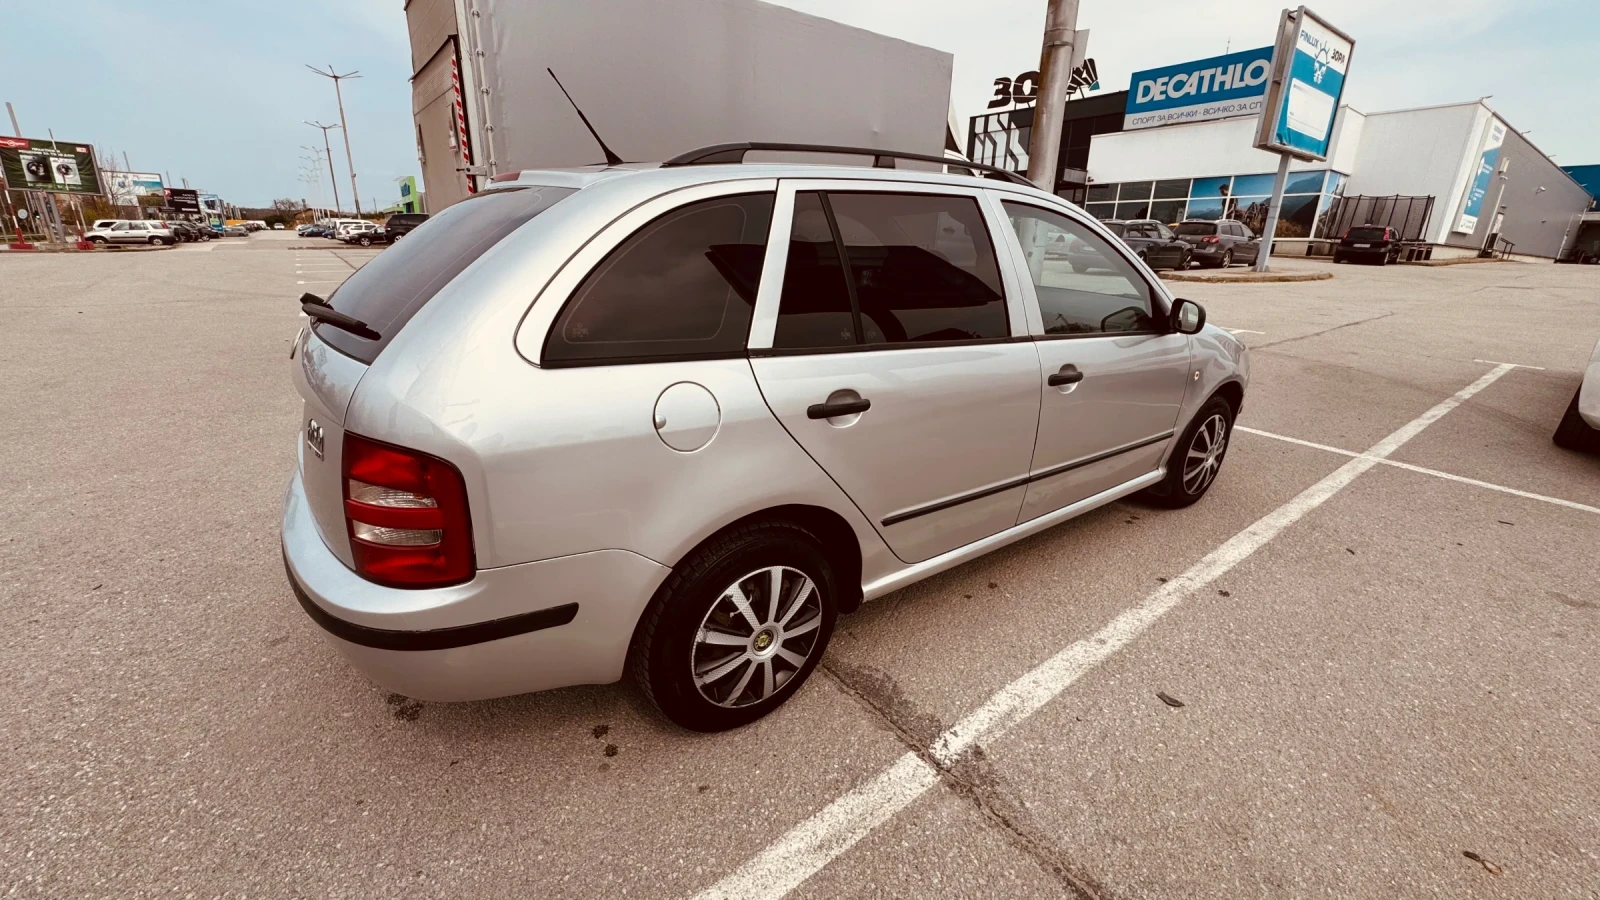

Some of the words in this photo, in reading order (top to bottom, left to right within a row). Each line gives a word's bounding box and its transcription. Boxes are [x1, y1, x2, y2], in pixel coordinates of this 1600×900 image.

[1300, 29, 1319, 49] FINLUX
[1132, 115, 1156, 126] СПОРТ
[1157, 114, 1166, 122] ЗА
[1167, 110, 1198, 121] ВСИЧКИ
[1203, 104, 1235, 117] ВСИЧКО
[1236, 103, 1247, 112] ЗА
